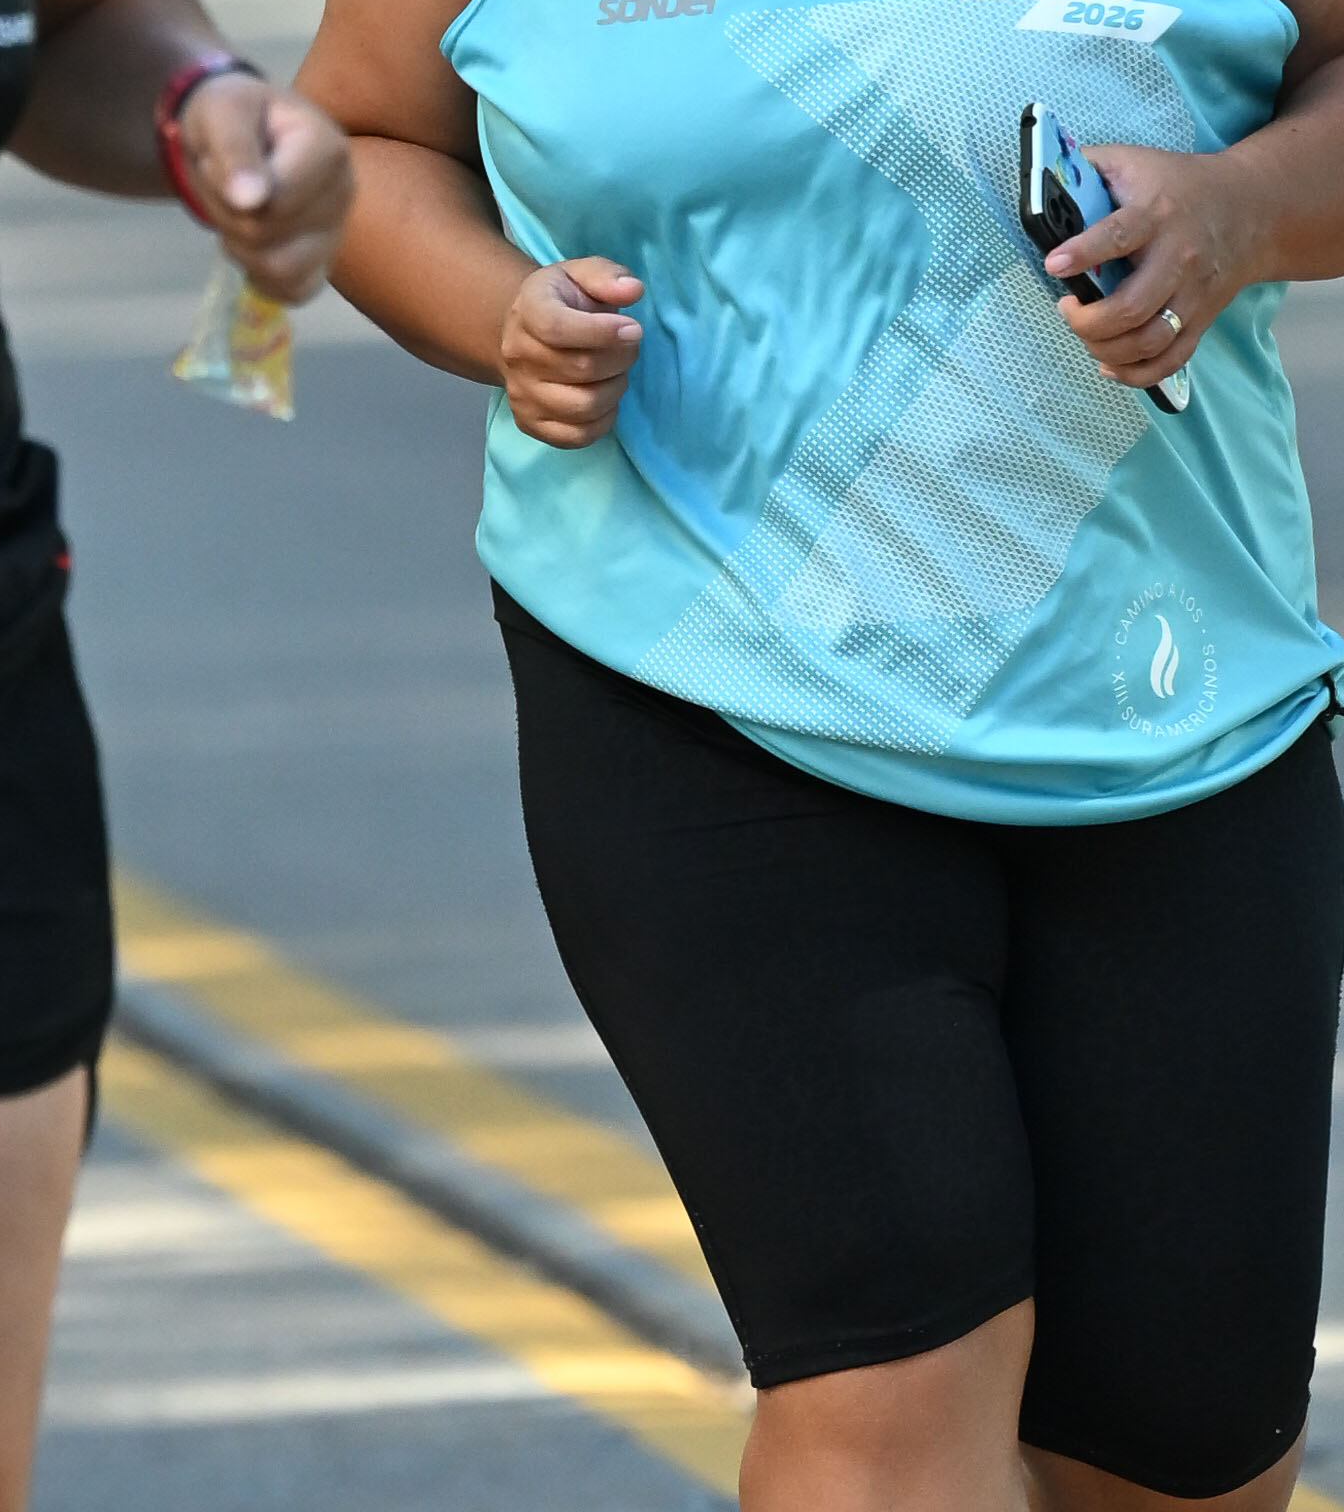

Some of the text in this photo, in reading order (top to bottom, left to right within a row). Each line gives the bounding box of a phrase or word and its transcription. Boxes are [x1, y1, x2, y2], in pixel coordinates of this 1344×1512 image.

[1062, 1, 1145, 31] 2026
[1115, 583, 1164, 645] CAMINO
[1178, 588, 1203, 623] LOS
[1121, 643, 1218, 739] SURAMERICANOS
